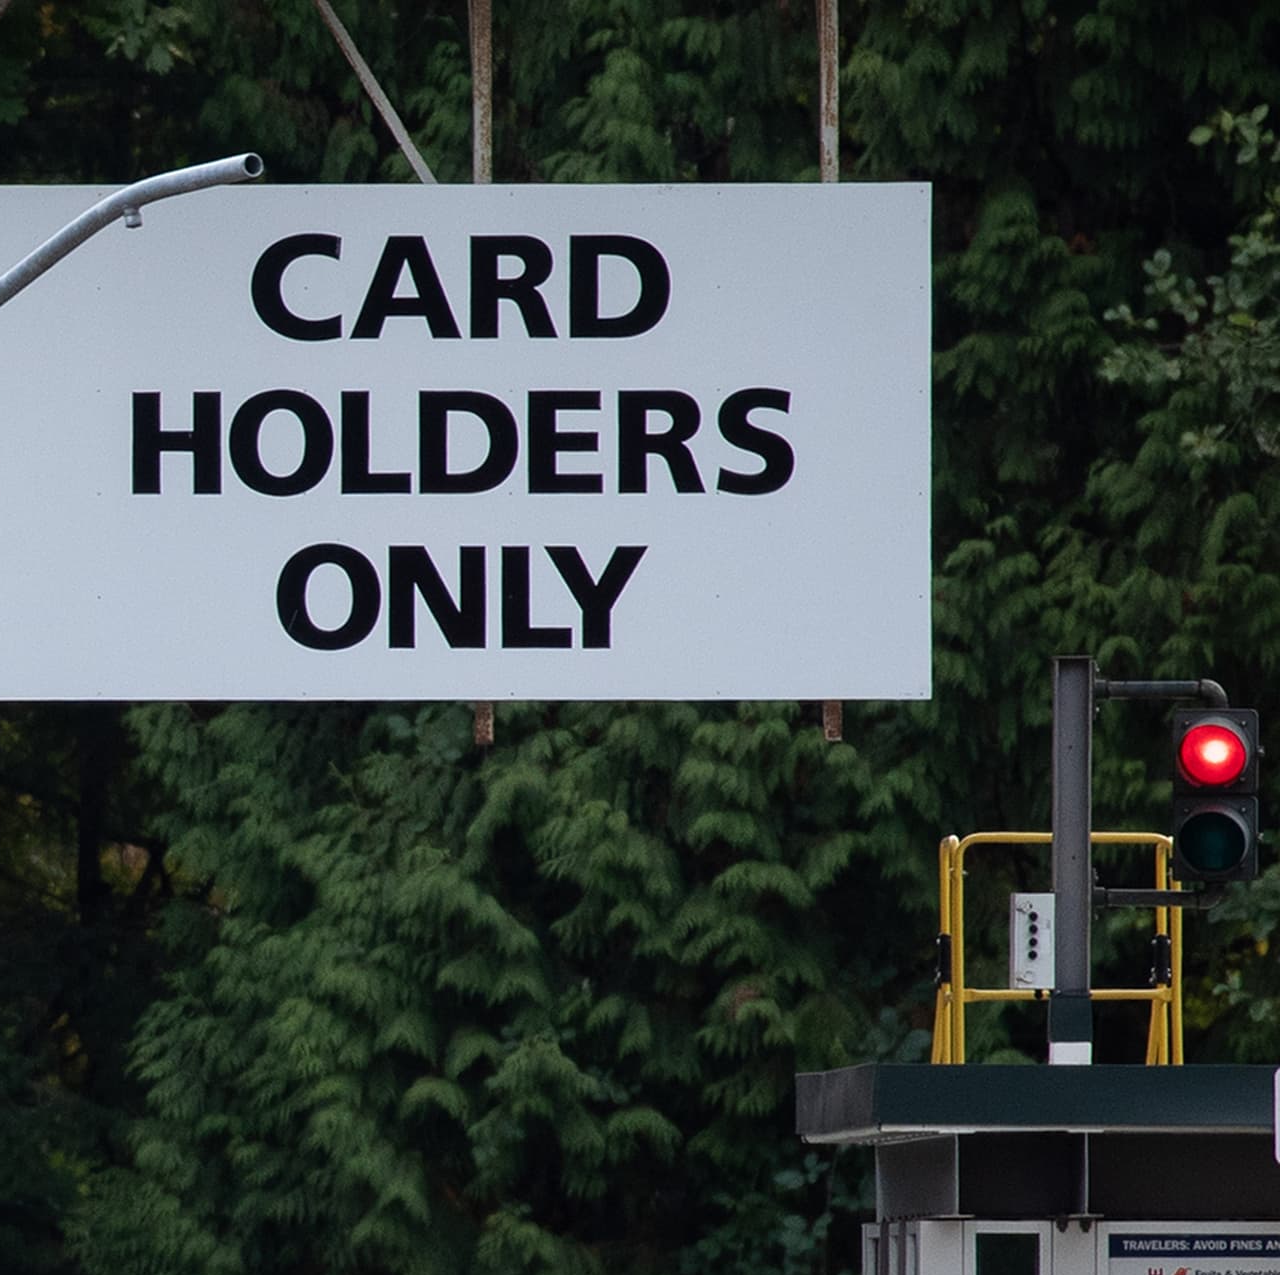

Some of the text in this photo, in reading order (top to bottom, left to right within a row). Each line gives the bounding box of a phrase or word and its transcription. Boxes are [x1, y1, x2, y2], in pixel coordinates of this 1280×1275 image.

[249, 232, 672, 342] CARD
[131, 387, 796, 497] HOLDERS
[275, 542, 649, 652] ONLY
[1122, 1240, 1190, 1251] TRAVELERS:
[1193, 1240, 1227, 1250] AVOID
[1230, 1240, 1262, 1250] FINES
